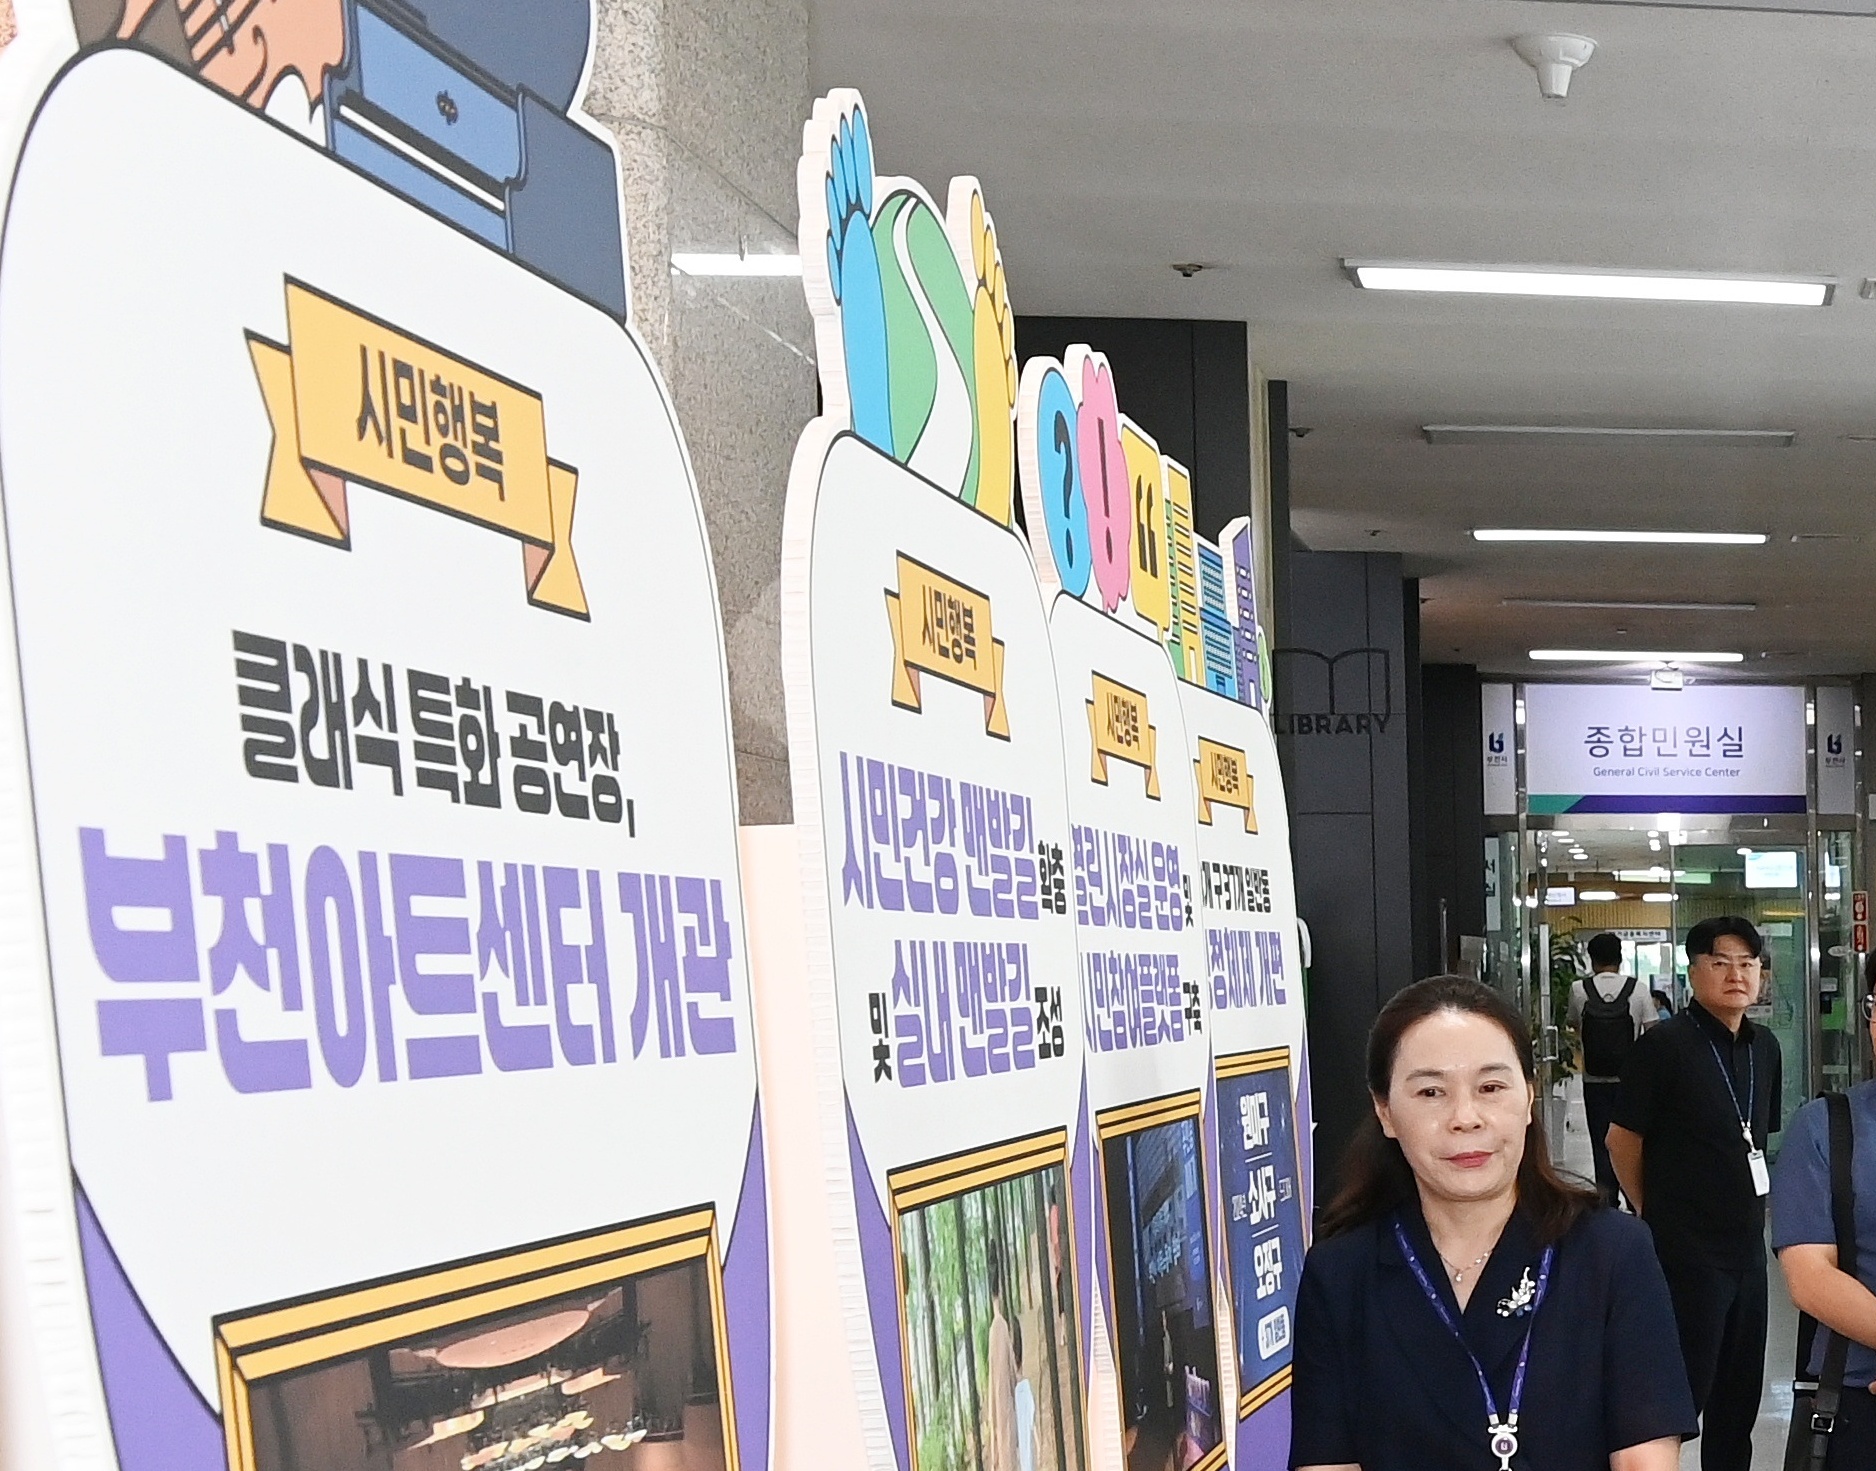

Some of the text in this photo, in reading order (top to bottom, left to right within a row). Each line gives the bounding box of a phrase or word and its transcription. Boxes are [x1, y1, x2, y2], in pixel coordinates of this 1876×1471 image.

[355, 343, 506, 502] 시민행복
[921, 583, 978, 672] 시민행복
[232, 629, 636, 838] 클래식 특화 공연장,
[1107, 692, 1140, 751] 시민행복
[1275, 714, 1389, 735] LIBRARY
[1584, 725, 1744, 758] 종합민원실
[1210, 751, 1240, 796] 시민행복
[1593, 766, 1740, 777] General Civil Service Center
[839, 750, 1066, 920] 시민건강 맨발길 확충
[1151, 841, 1183, 931] 운영
[77, 826, 737, 1104] 부천아트센터 개관
[1205, 926, 1287, 1011] 정체제 개편
[868, 938, 1065, 1089] 및 실내 맨발길 조성
